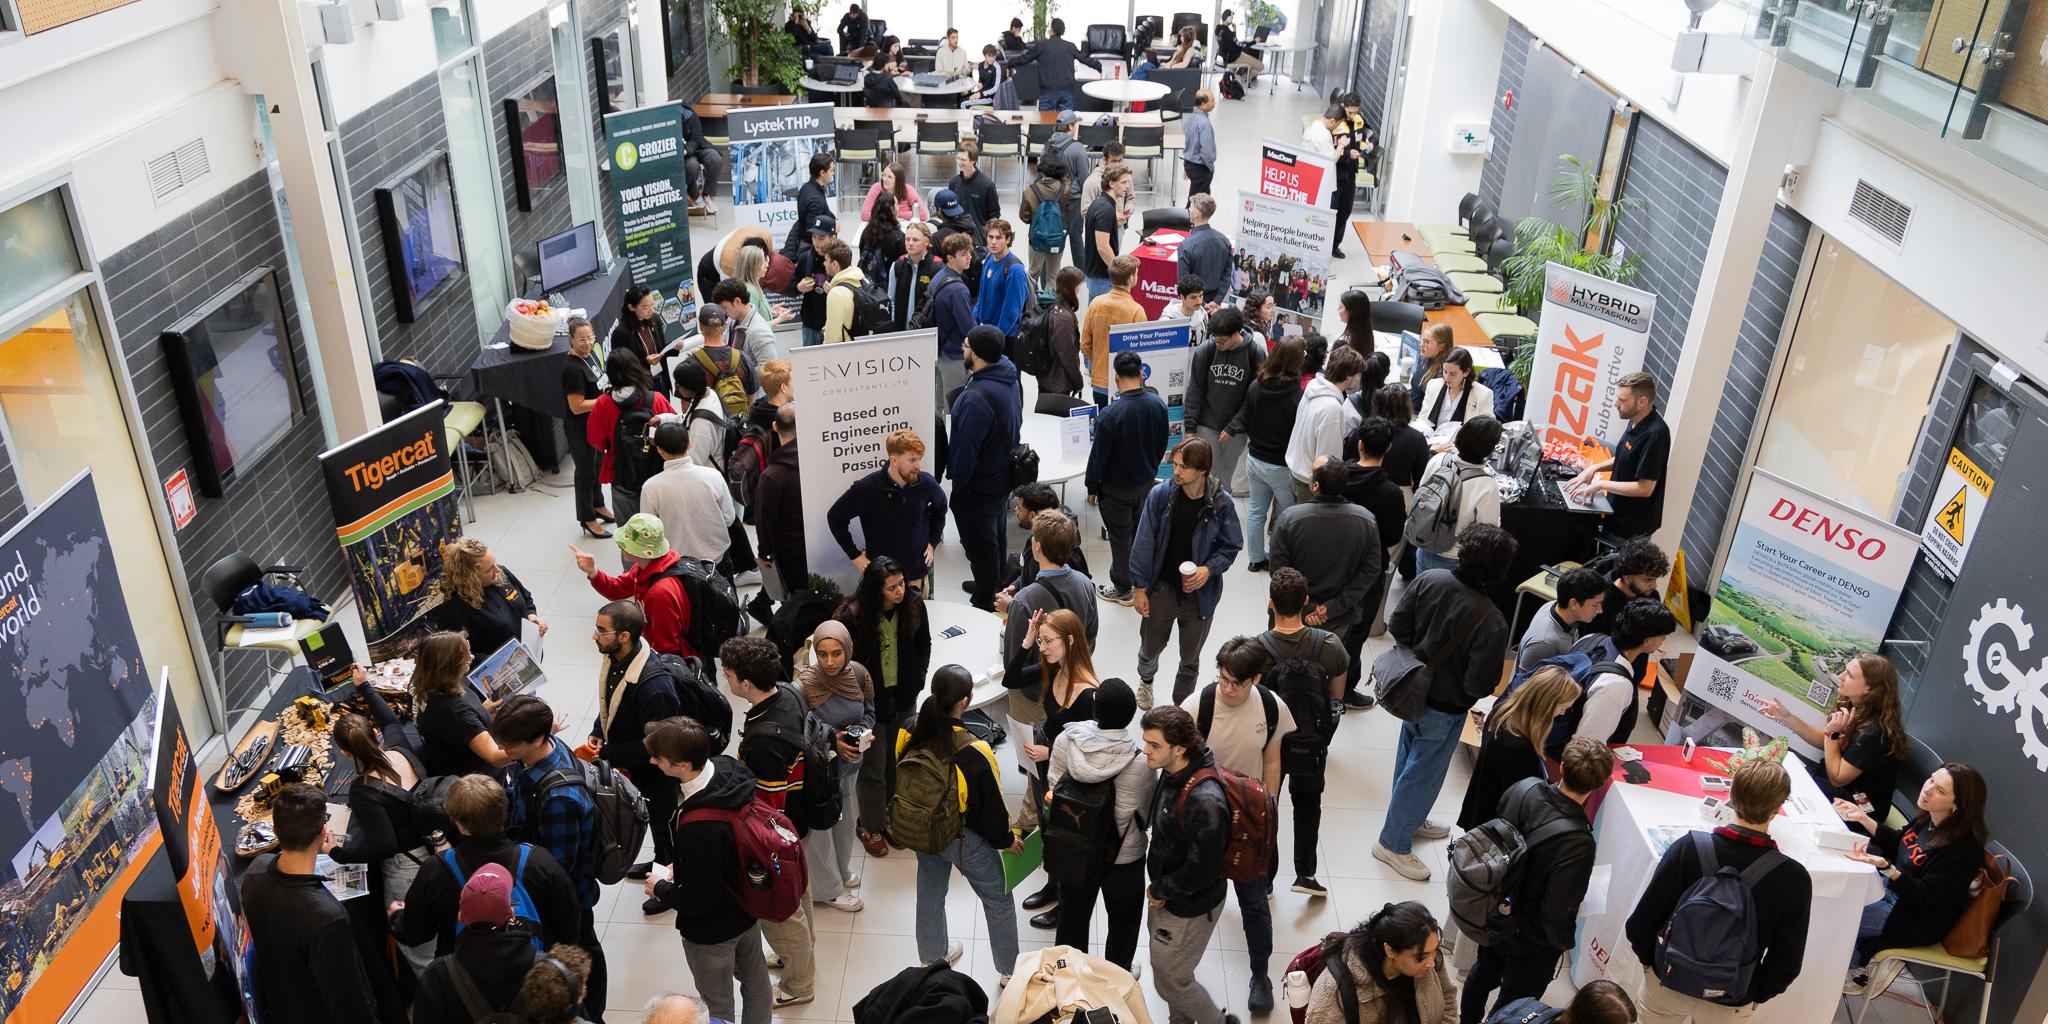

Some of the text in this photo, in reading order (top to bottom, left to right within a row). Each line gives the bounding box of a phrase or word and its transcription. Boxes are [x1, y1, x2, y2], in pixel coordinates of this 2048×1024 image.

[639, 137, 676, 157] CROZIER
[1267, 150, 1292, 163] MacDon
[1264, 165, 1299, 187] HELP US
[620, 179, 673, 202] YOUR VISION,
[622, 189, 682, 215] OUR EXPERTISE.
[1263, 180, 1308, 203] FEED THE
[759, 209, 797, 227] Lyste
[1243, 217, 1325, 242] Helping people breathe
[1242, 226, 1320, 252] better & live fuller lives.
[1571, 297, 1638, 325] MULTI-TASKING
[1572, 286, 1640, 315] HYBRID
[808, 355, 921, 382] ENVISION
[822, 382, 888, 396] CONSULTANTS
[1595, 346, 1624, 439] Subtractive
[833, 405, 900, 423] Based on
[822, 420, 913, 442] Engineering,
[344, 431, 436, 492] Tigercat
[833, 442, 880, 458] Driven
[842, 457, 890, 474] Passio
[1951, 454, 1989, 493] CAUTION
[1768, 497, 1887, 561] DENSO
[1926, 532, 1958, 567] TRIPPING HAZARDS
[1938, 532, 1946, 542] NOT
[1944, 538, 1959, 555] CREATE
[1756, 540, 1776, 555] Start
[1779, 550, 1798, 564] Your
[1798, 560, 1826, 577] Career
[1828, 574, 1836, 583] at
[1838, 577, 1870, 598] DENSO
[168, 725, 187, 824] Tigercat
